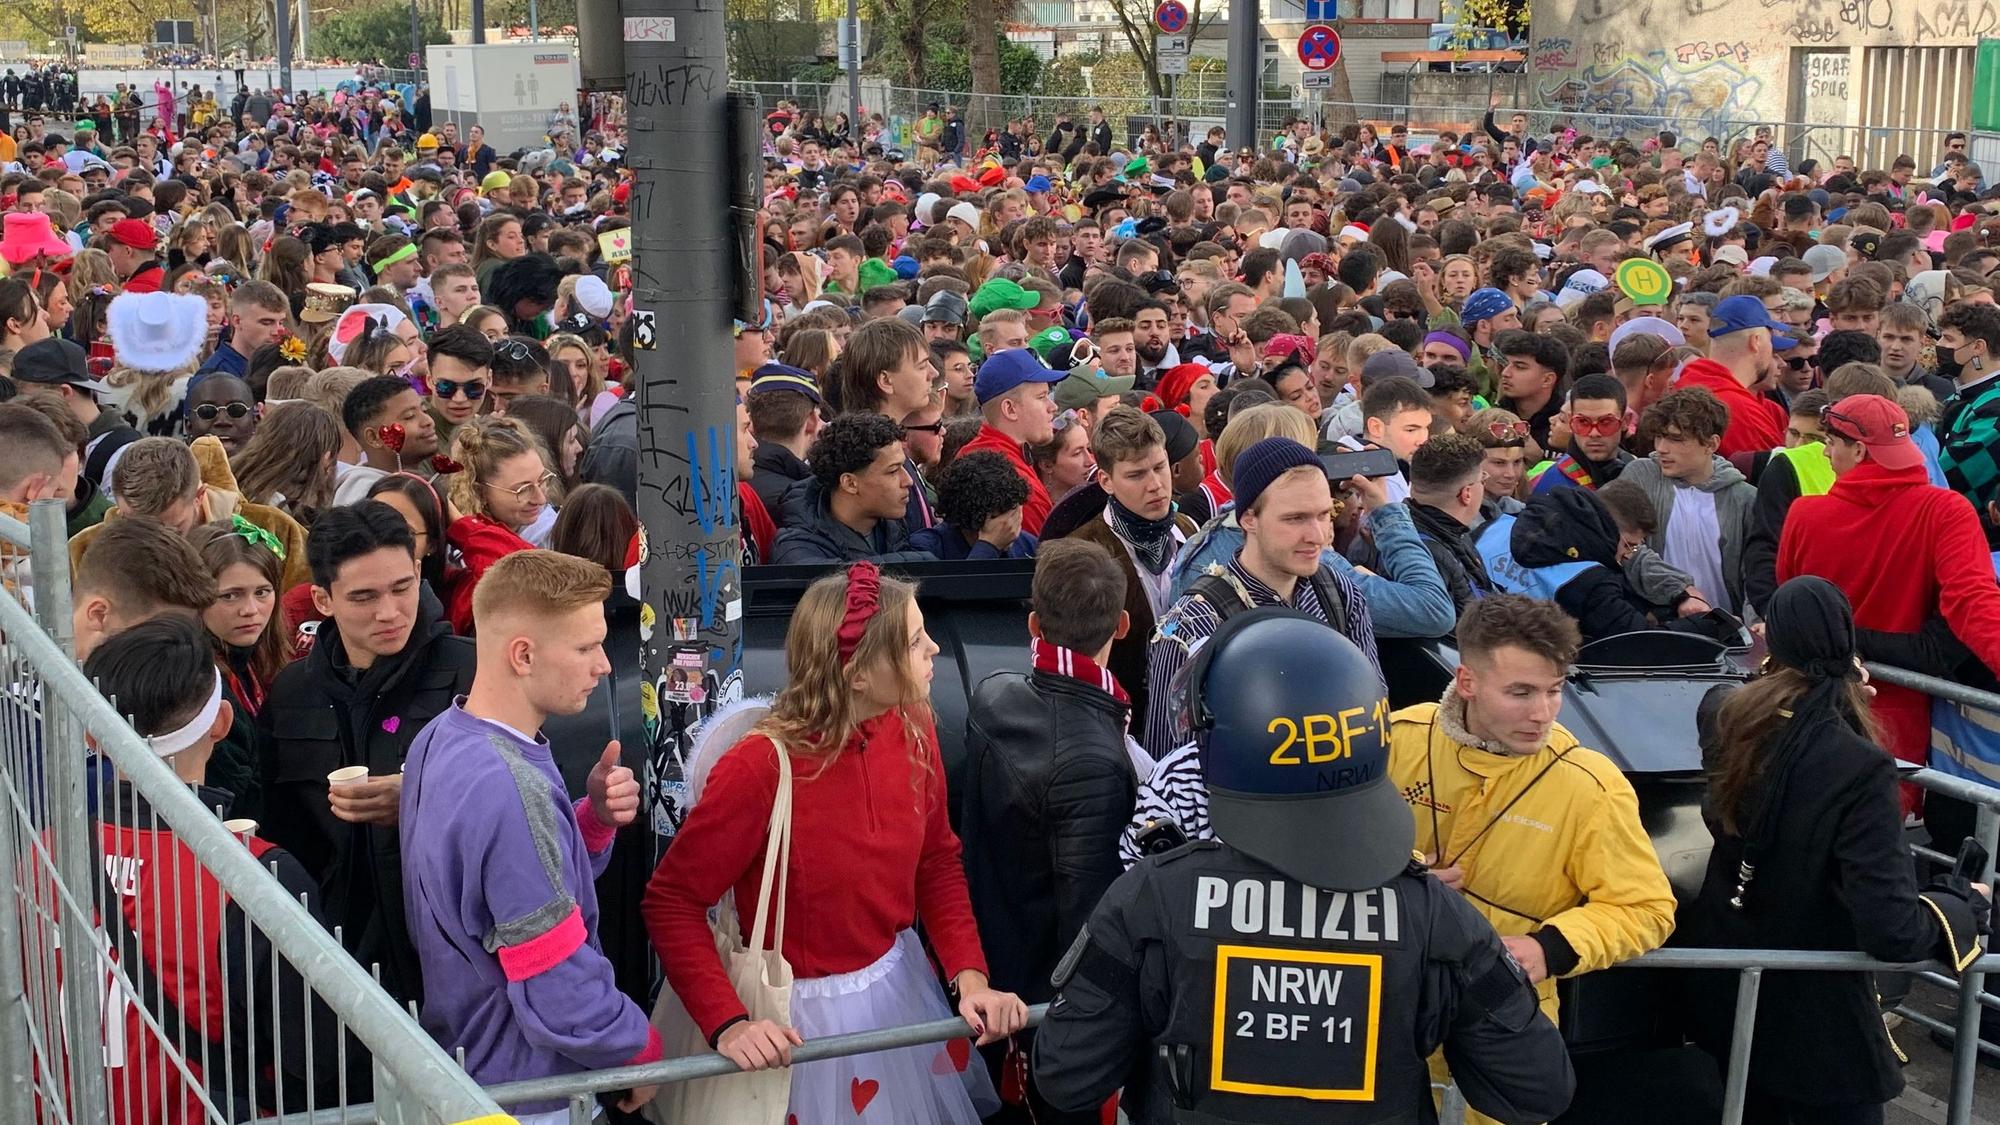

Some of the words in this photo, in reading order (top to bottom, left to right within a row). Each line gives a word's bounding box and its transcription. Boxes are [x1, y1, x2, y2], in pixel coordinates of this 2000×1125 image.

[1634, 270, 1654, 290] H
[1316, 761, 1377, 792] NRW
[1194, 876, 1399, 942] POLIZEI
[1252, 965, 1343, 1006] NRW
[1236, 1010, 1255, 1038] 2
[1266, 1013, 1310, 1041] BF
[1321, 1016, 1353, 1044] 11
